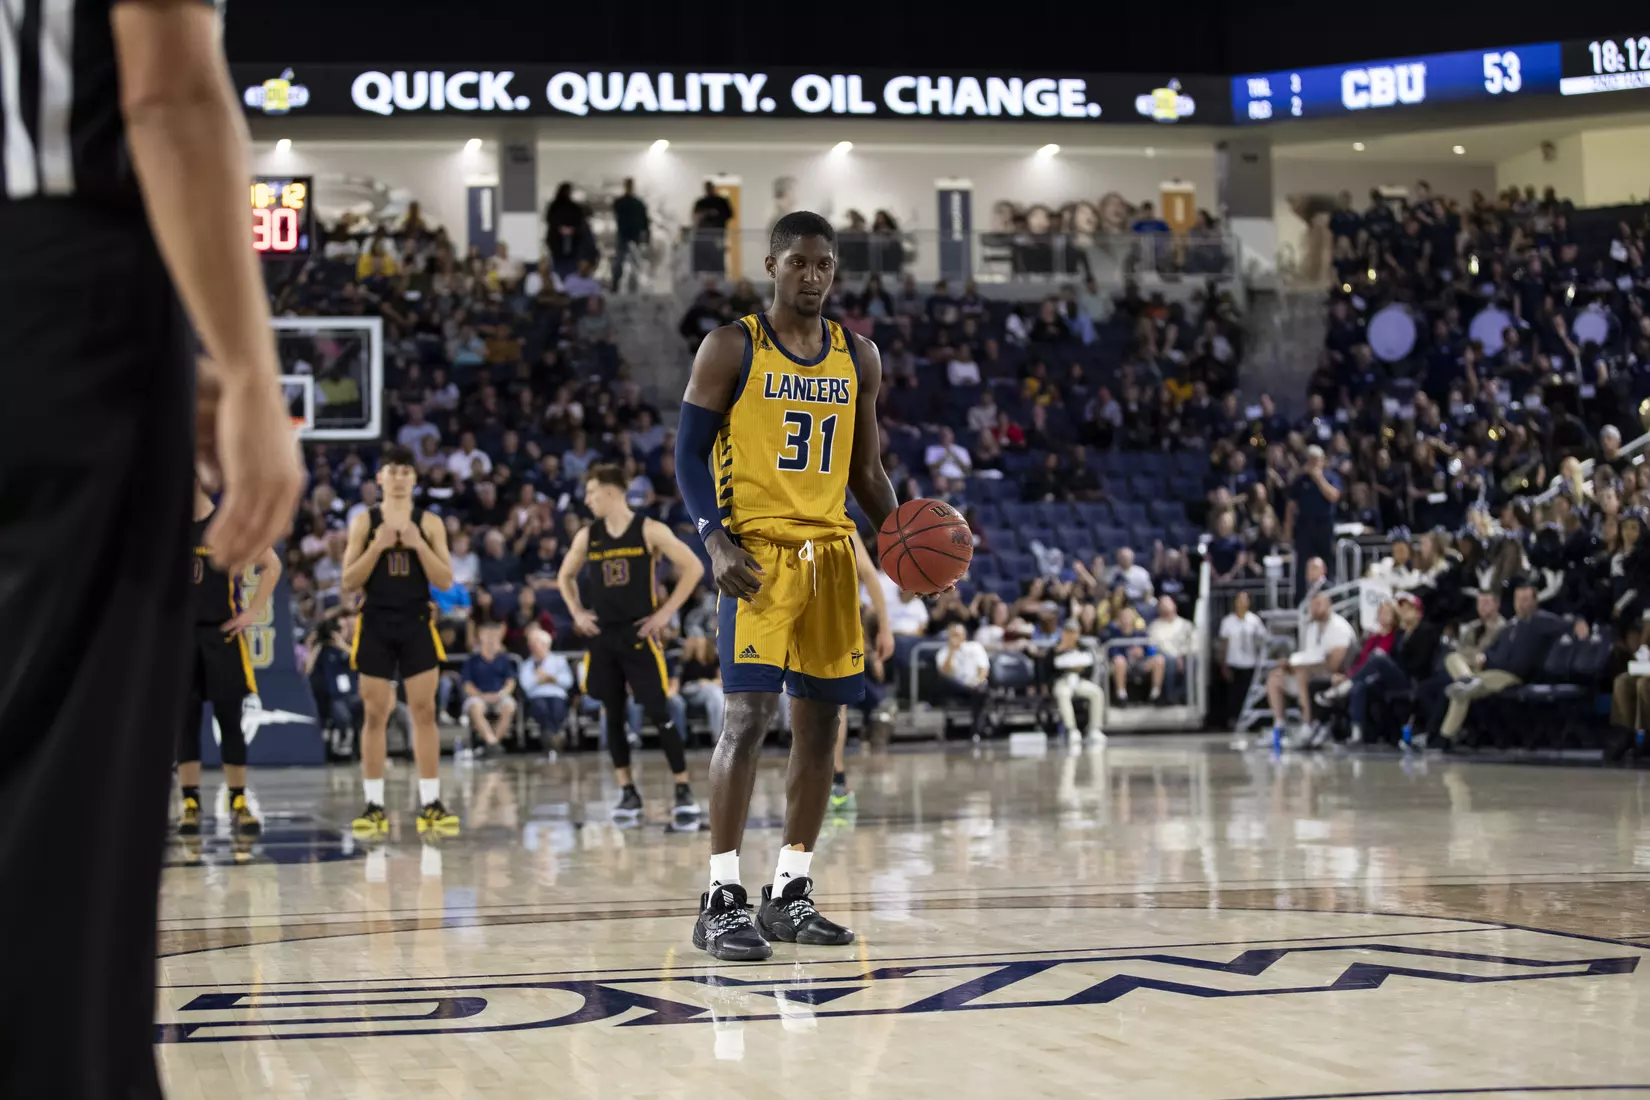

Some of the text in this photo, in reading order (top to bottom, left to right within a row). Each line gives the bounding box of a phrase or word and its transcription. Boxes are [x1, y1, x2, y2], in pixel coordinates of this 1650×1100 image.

[1483, 51, 1522, 95] 53
[1588, 36, 1650, 74] 18:12
[351, 70, 531, 116] QUICK.
[546, 71, 777, 116] QUALITY.
[791, 73, 877, 114] OIL
[883, 75, 1102, 118] CHANGE.
[1341, 62, 1427, 109] CBU
[252, 208, 298, 252] 30
[763, 372, 850, 405] LANCERS
[776, 410, 838, 474] 31
[388, 550, 410, 577] 11
[602, 558, 631, 588] 13
